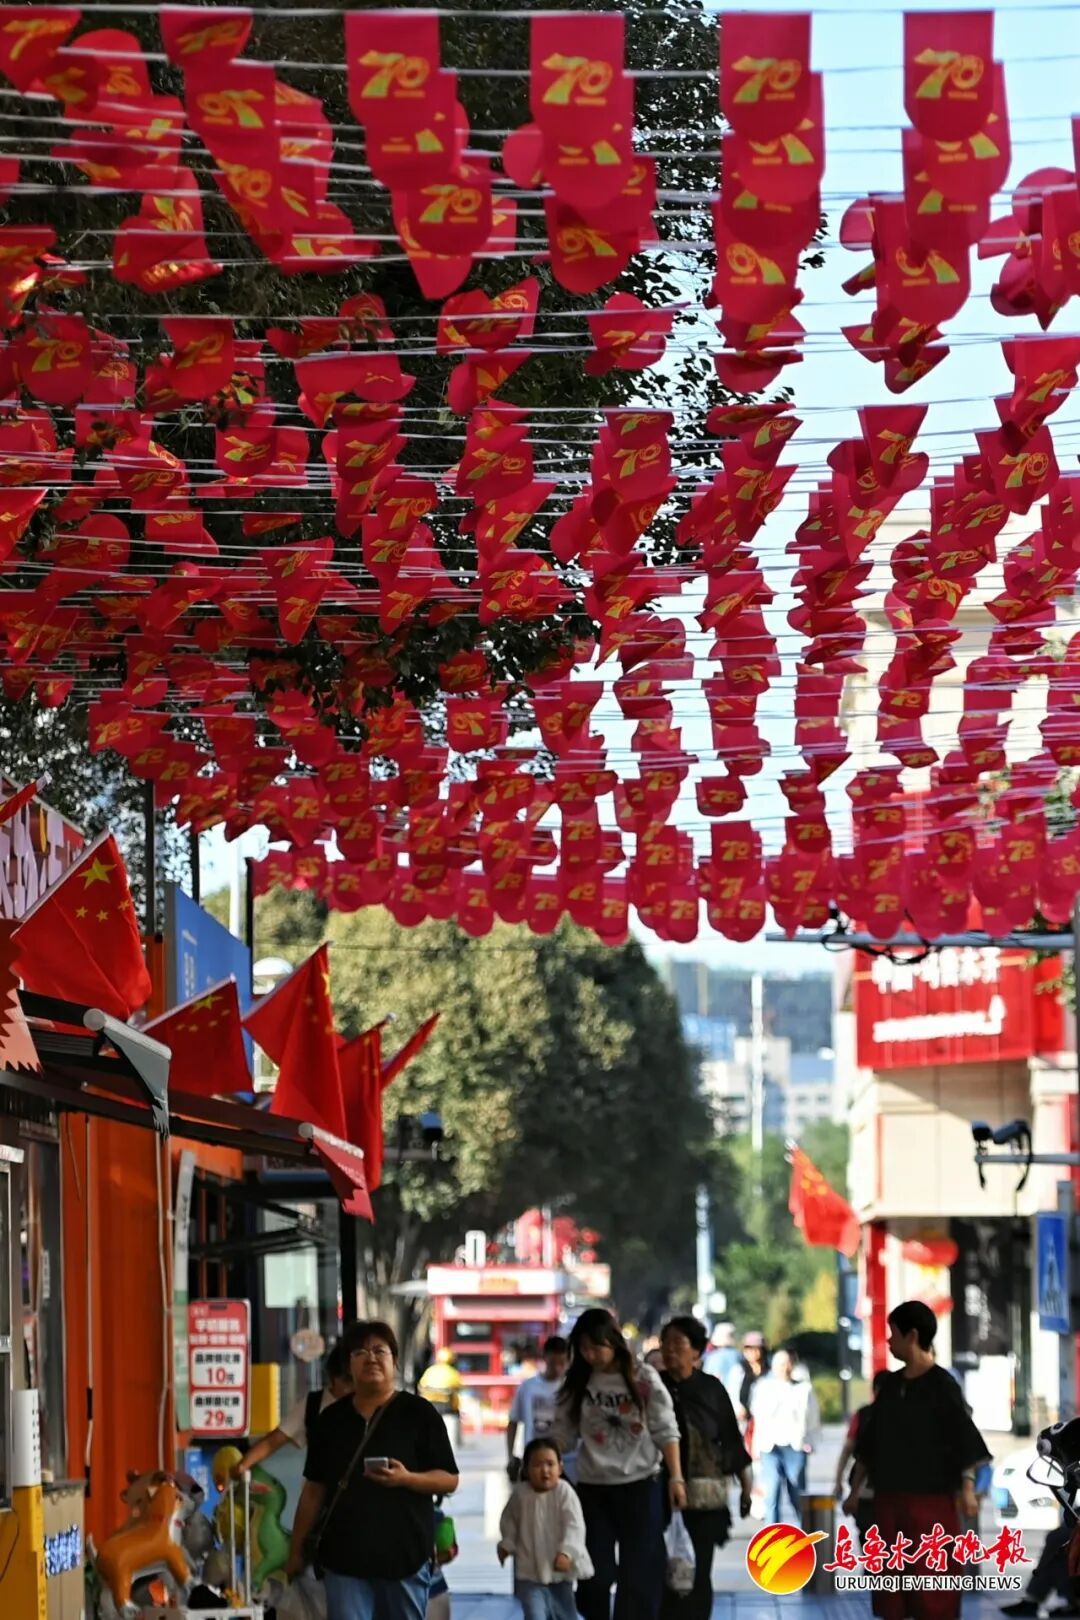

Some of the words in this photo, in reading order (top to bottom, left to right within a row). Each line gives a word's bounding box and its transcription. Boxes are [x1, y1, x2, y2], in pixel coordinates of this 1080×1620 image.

[358, 49, 430, 98] 70
[541, 52, 613, 105] 70
[731, 54, 802, 104] 70
[914, 47, 985, 99] 70
[419, 183, 482, 224] 70
[27, 336, 83, 373] 70
[174, 331, 226, 370] 70
[466, 447, 527, 480] 70
[612, 443, 662, 480] 70
[999, 451, 1050, 490] 70
[384, 497, 434, 530] 70
